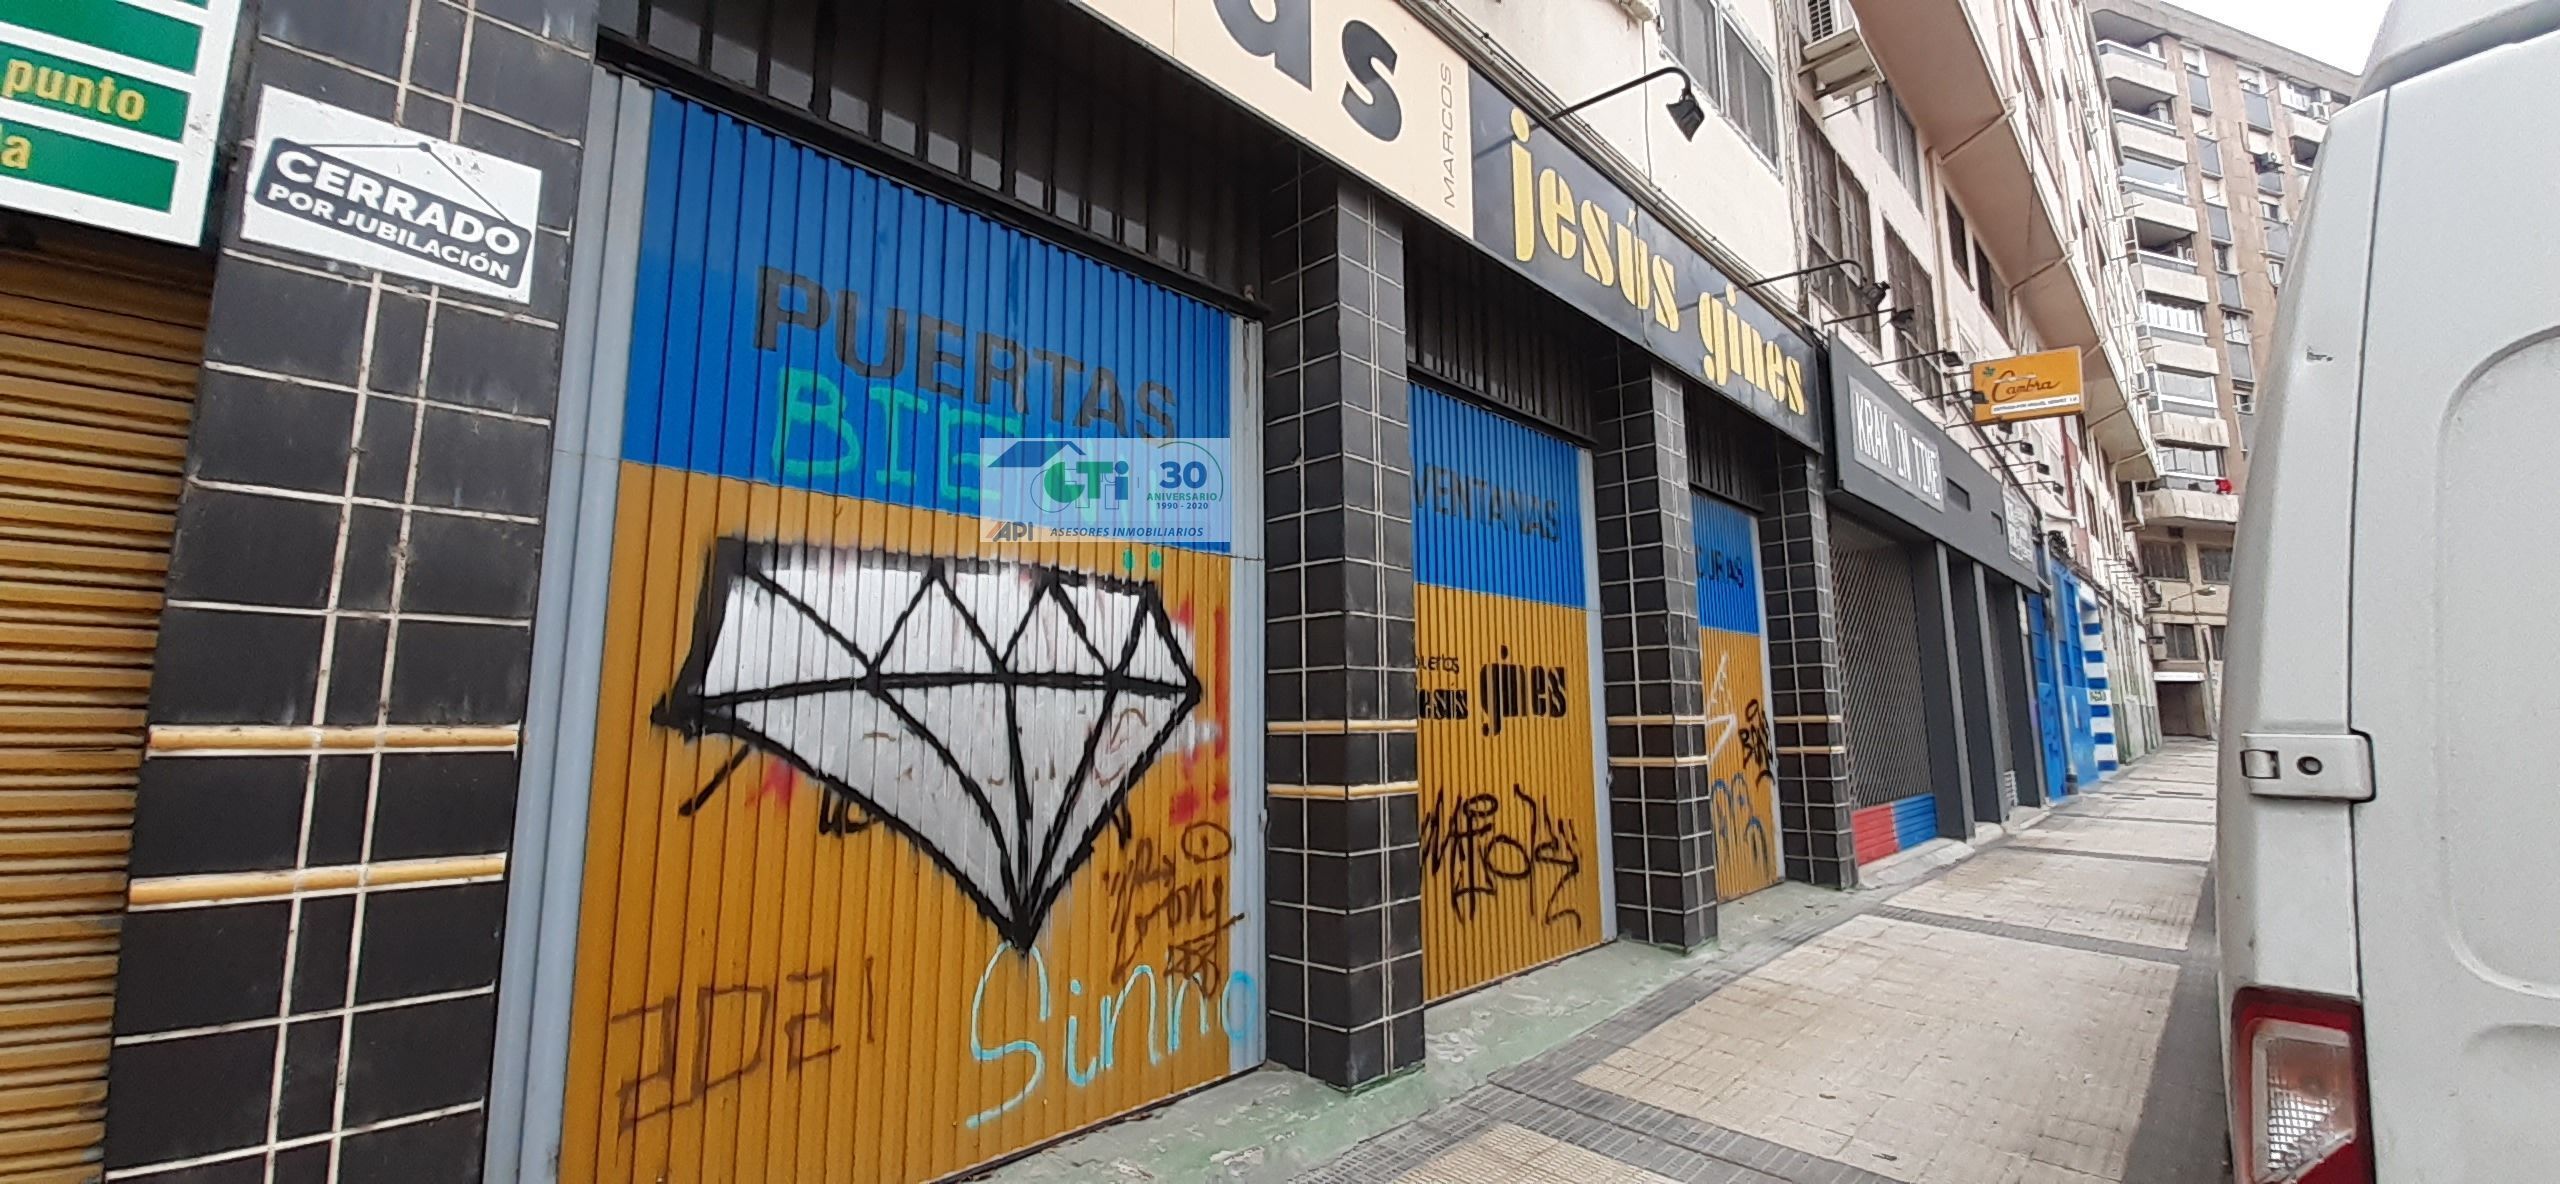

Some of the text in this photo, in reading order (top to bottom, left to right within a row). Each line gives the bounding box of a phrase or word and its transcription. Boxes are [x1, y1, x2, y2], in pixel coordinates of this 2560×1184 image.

[2, 59, 145, 121] punto
[1440, 62, 1455, 208] MARCOS
[0, 123, 31, 169] a
[267, 183, 511, 281] POR JUBILACIÓN
[275, 150, 520, 255] CERRADO
[1510, 107, 1806, 416] jesús gines
[753, 264, 1178, 446] PUERTAS
[1992, 369, 2061, 403] Cambra
[1855, 392, 1941, 500] KRAK IN TIME
[1415, 462, 1560, 543] VENTANAS
[1479, 644, 1567, 737] gines
